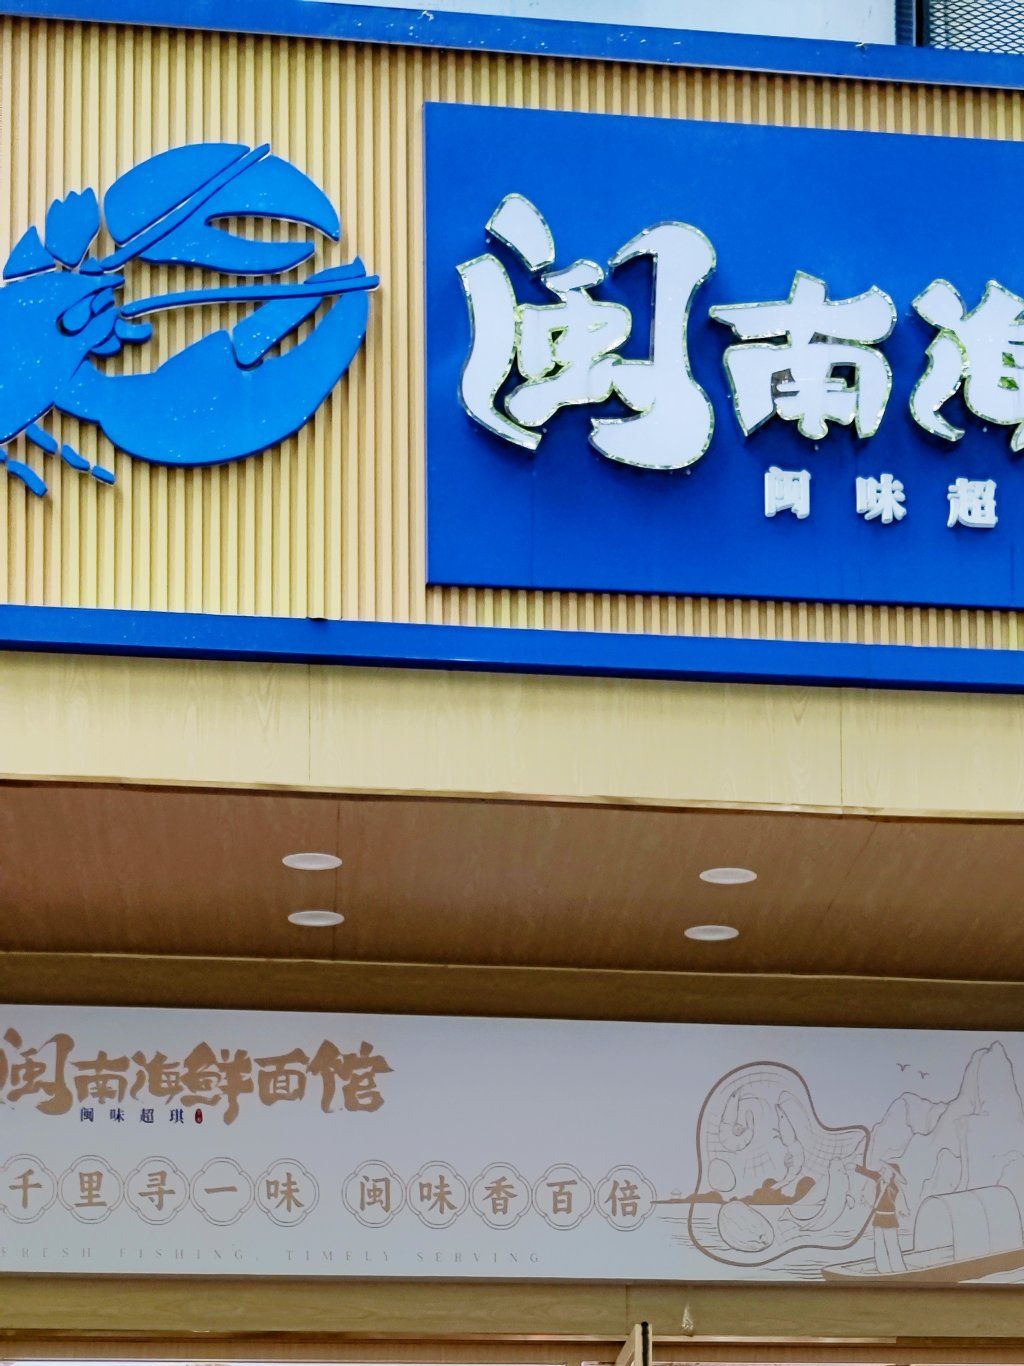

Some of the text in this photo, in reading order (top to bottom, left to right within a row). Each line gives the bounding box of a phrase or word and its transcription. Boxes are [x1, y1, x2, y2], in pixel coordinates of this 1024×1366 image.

[0, 1027, 395, 1126] 闽南海鲜面馆
[80, 1107, 184, 1124] 闽味超琪
[8, 1168, 303, 1211] 千里寻一味
[357, 1174, 642, 1219] 闽味香百倍
[416, 1251, 541, 1264] SERVING
